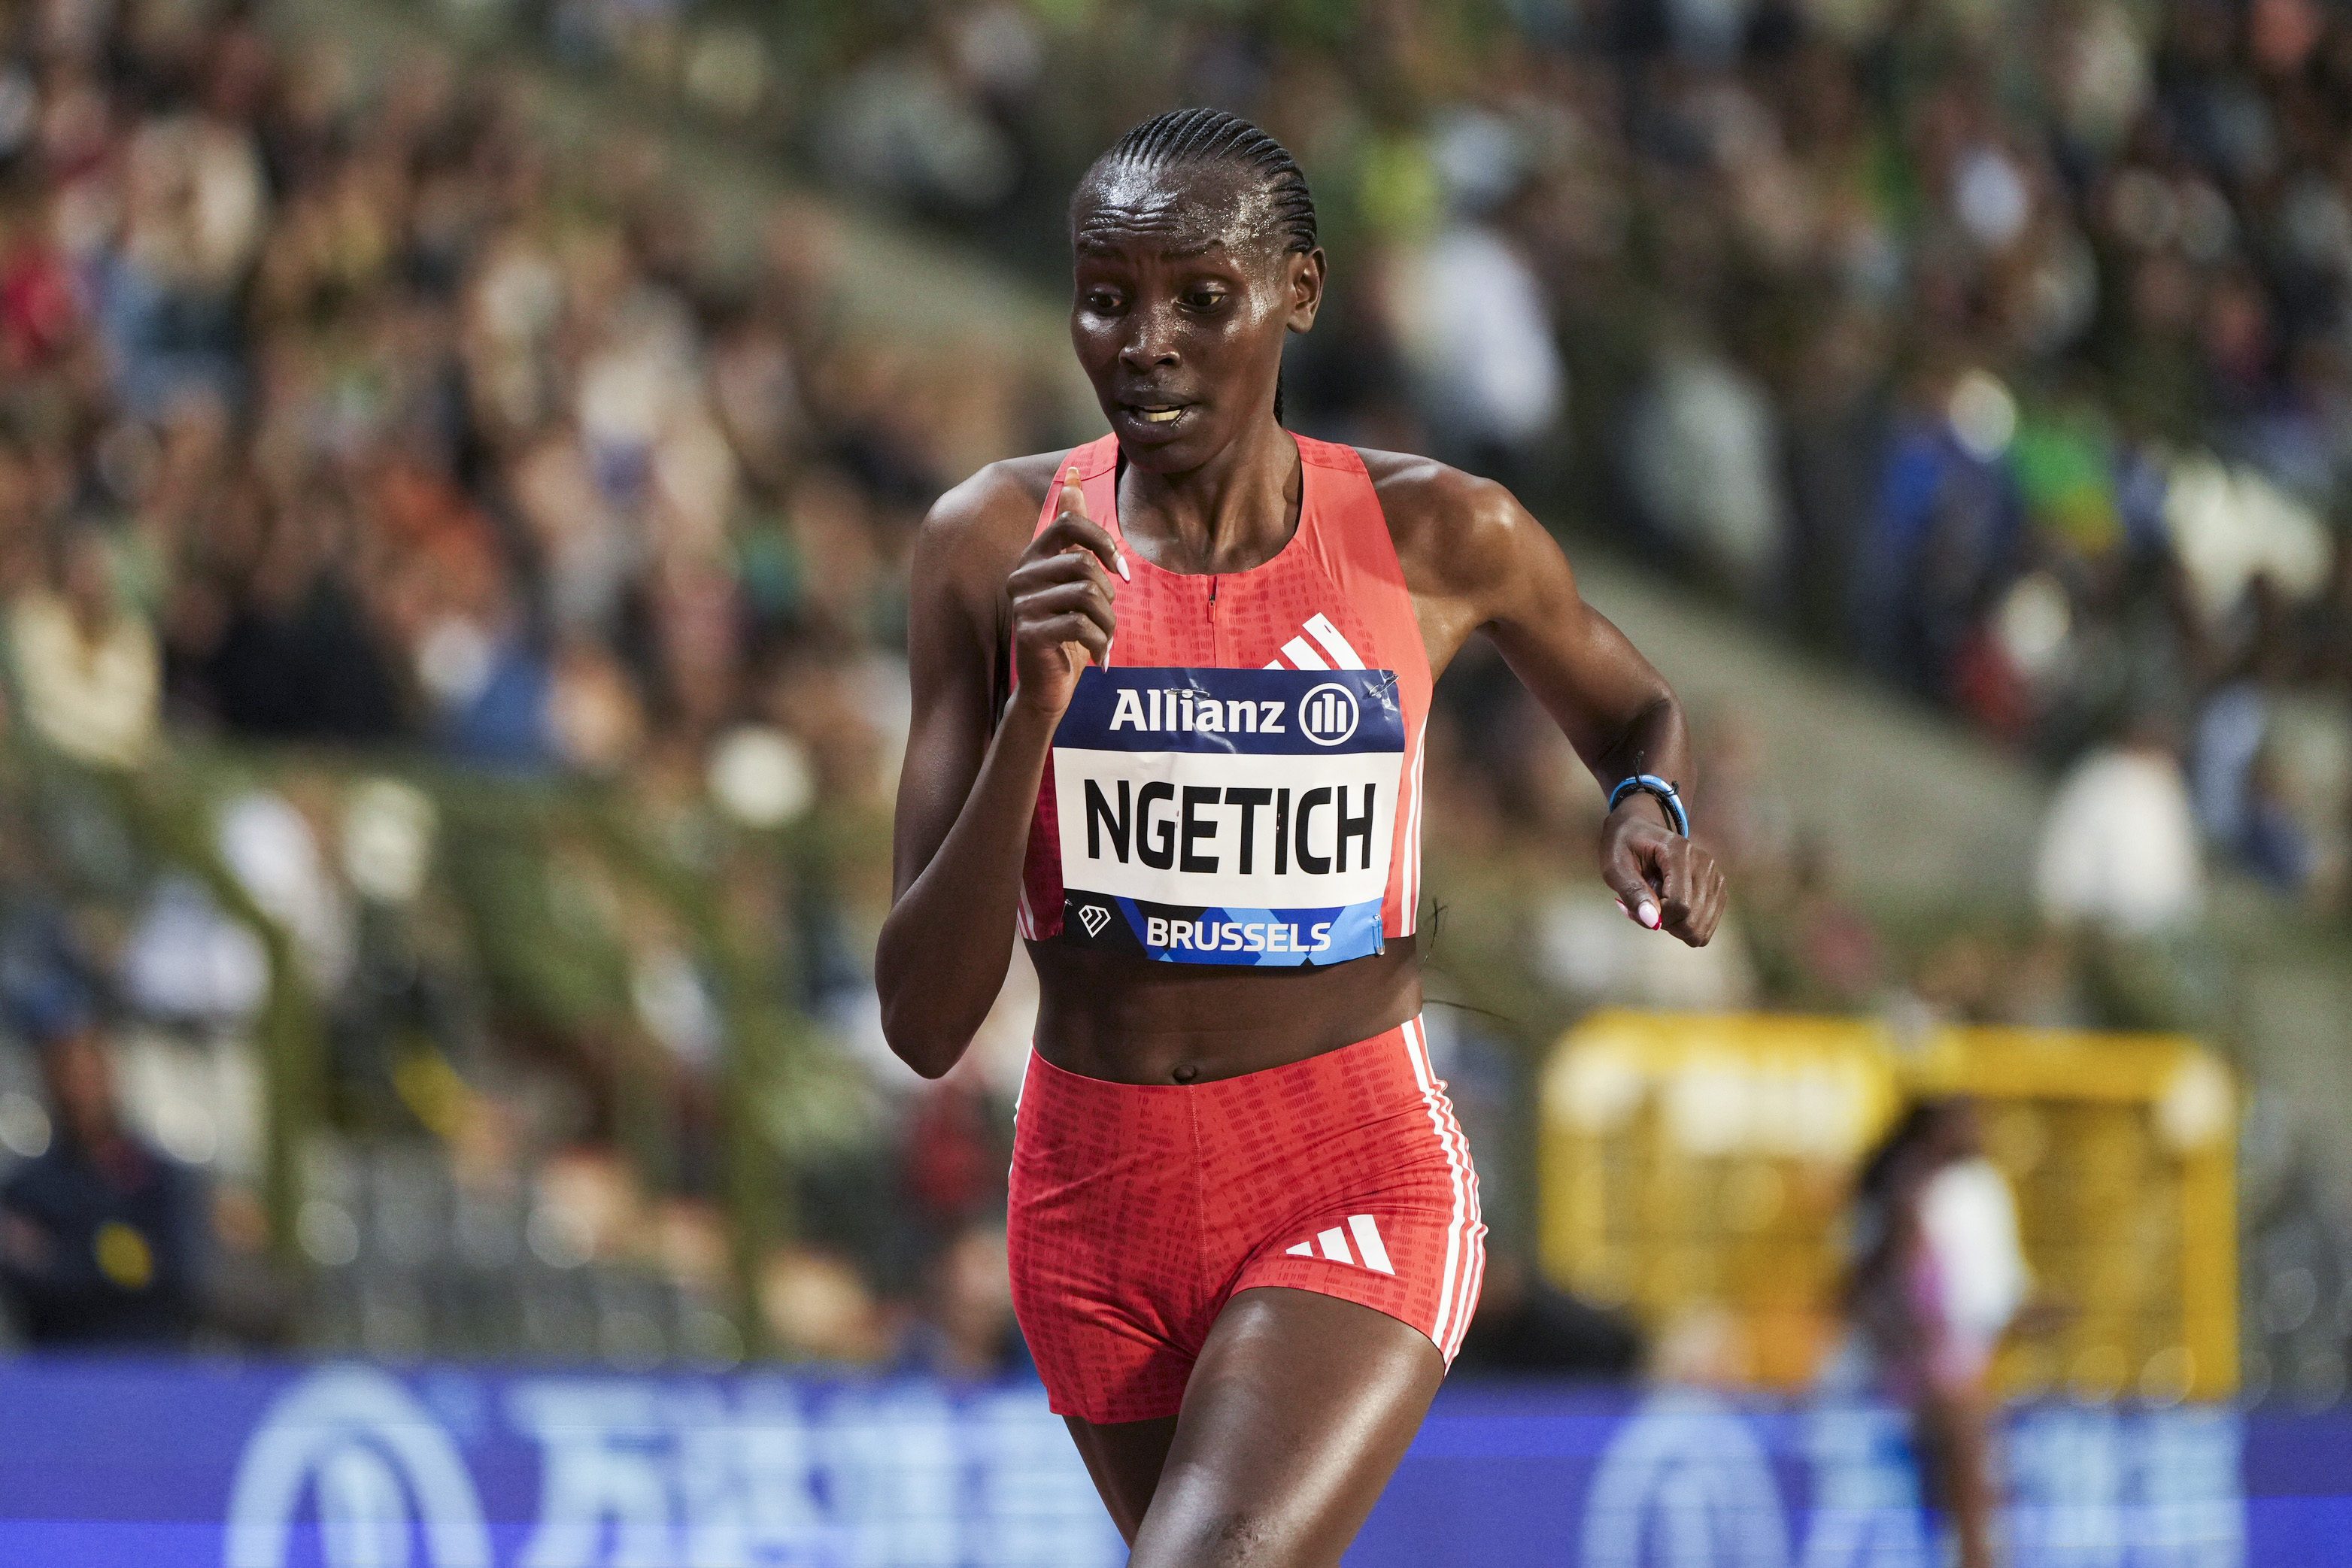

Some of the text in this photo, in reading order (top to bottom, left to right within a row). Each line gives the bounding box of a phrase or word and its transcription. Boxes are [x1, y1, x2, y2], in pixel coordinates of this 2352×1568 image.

[1109, 688, 1285, 733] Allianz
[1084, 779, 1376, 875] NGETICH
[1146, 916, 1331, 953] BRUSSELS
